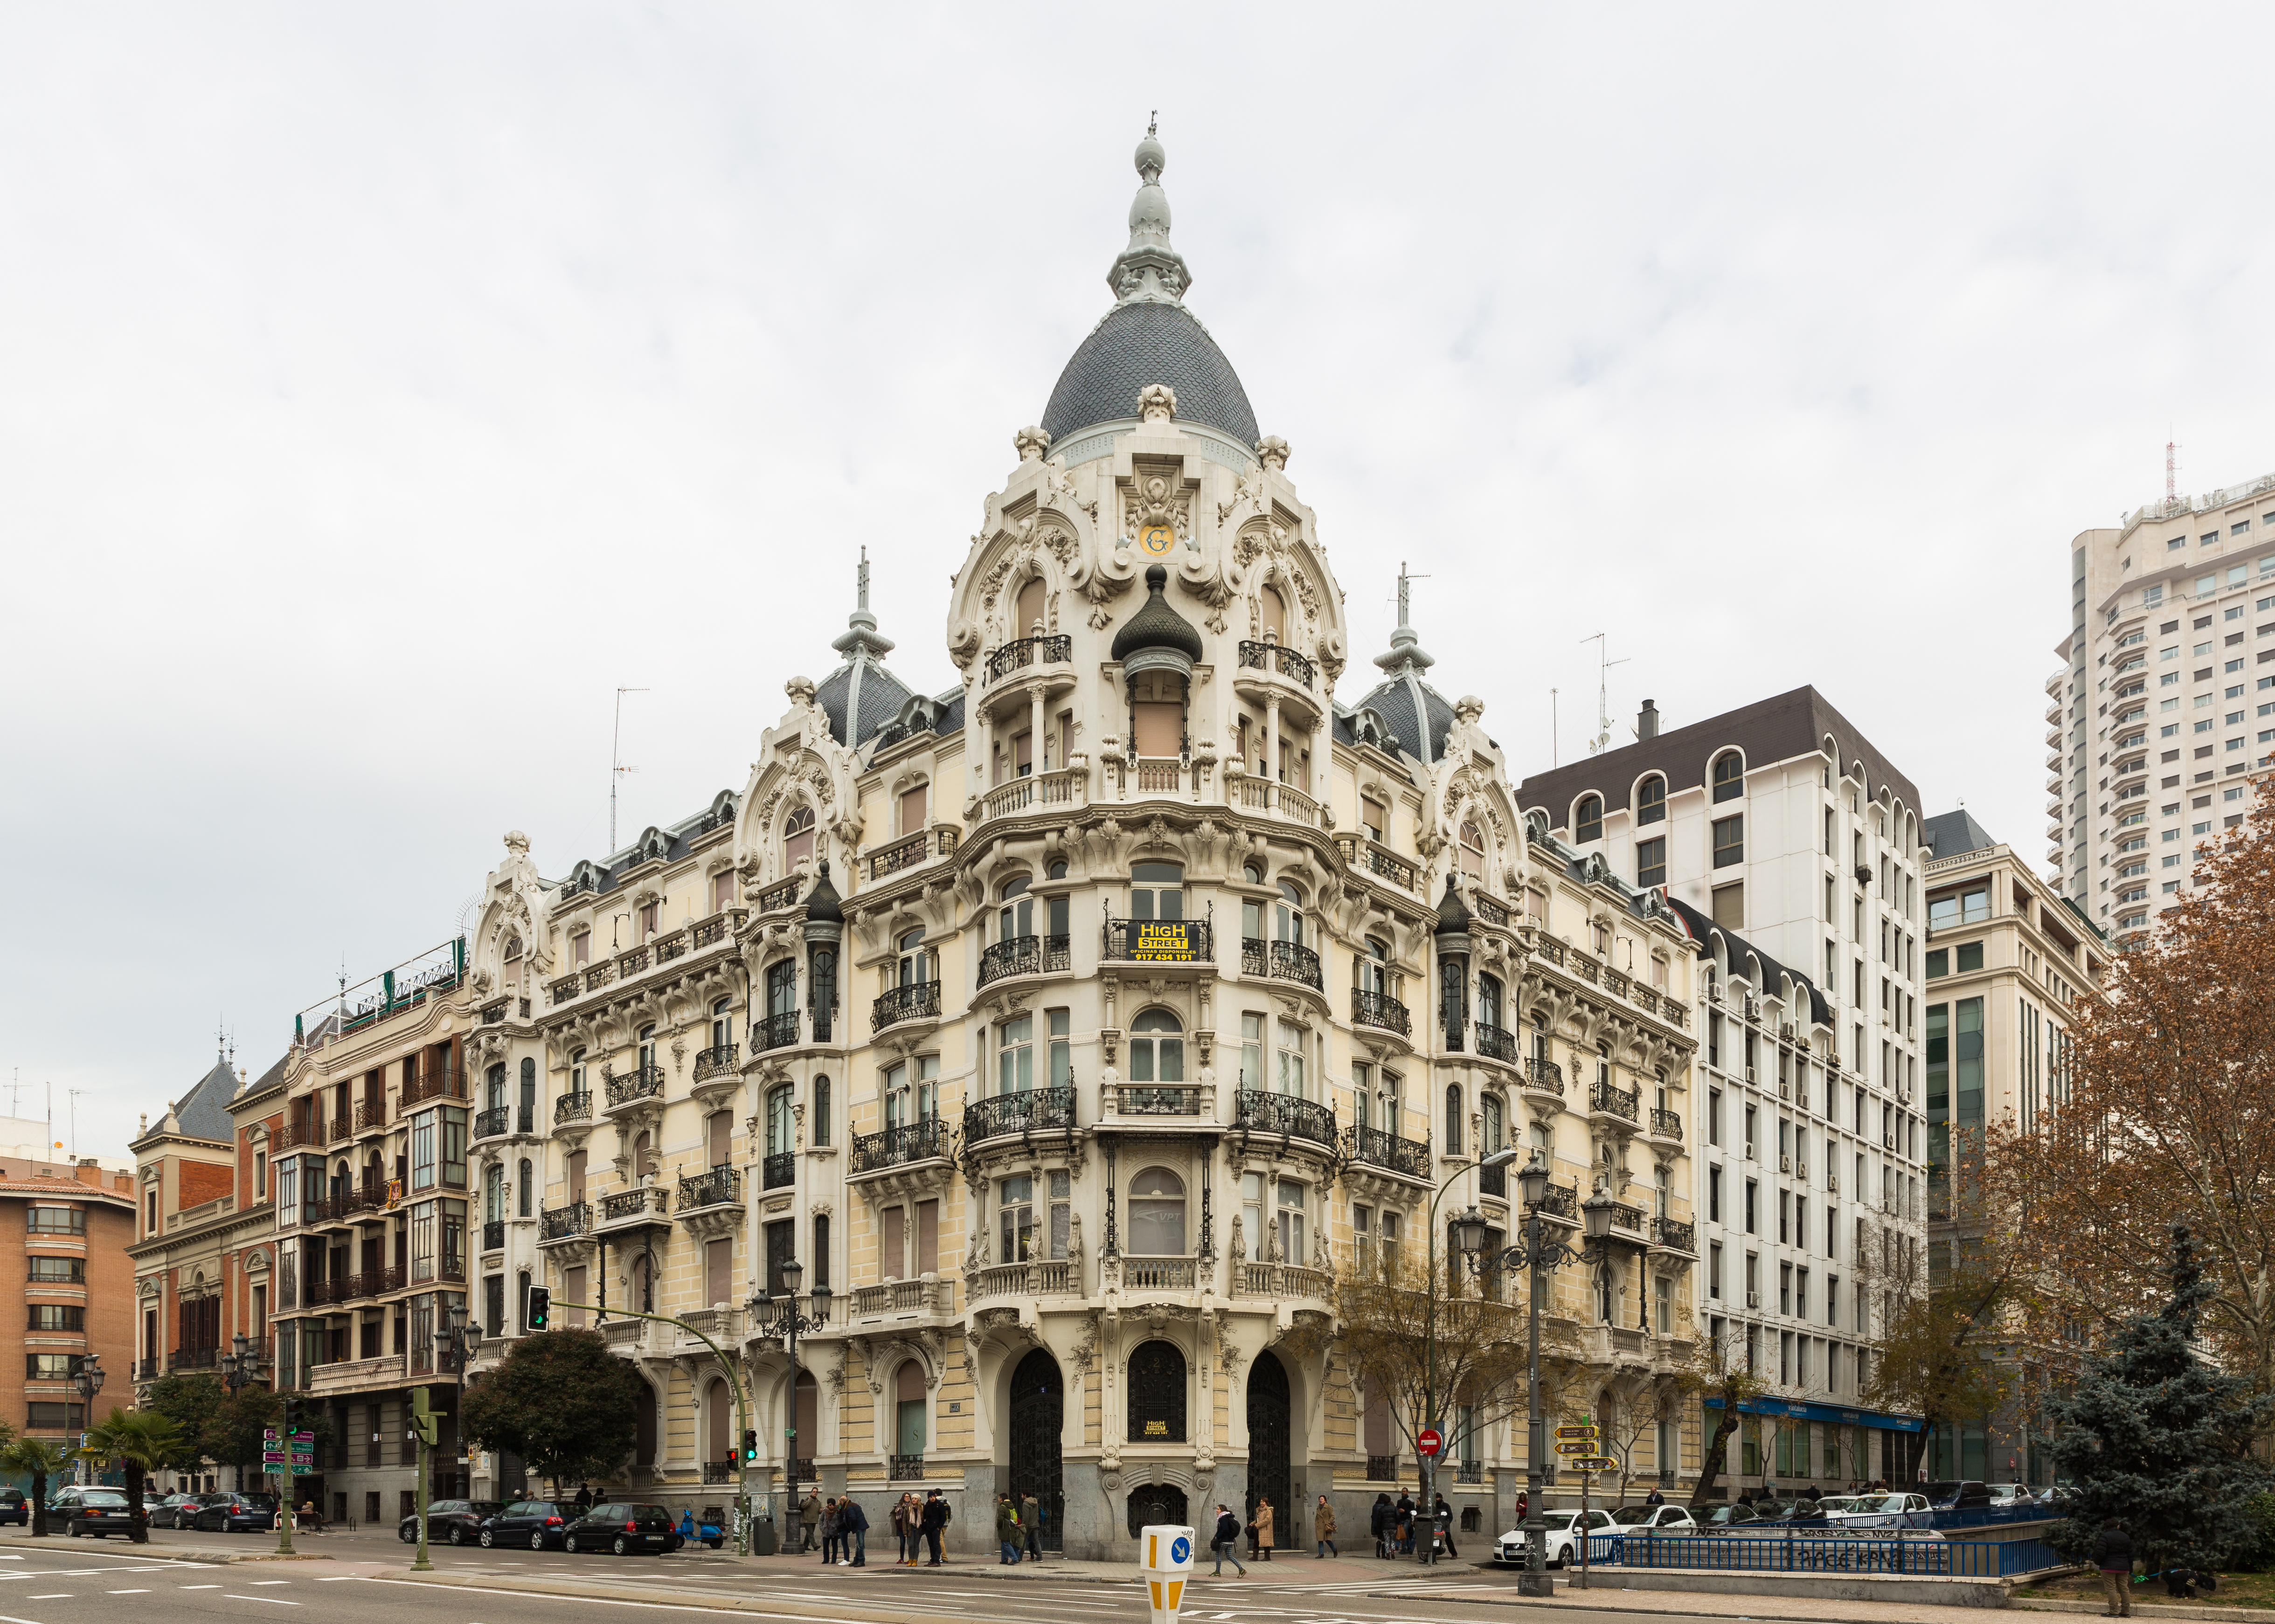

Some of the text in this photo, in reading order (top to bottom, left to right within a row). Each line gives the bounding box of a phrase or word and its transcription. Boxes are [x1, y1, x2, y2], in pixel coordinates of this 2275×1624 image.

[1145, 529, 1168, 552] G
[1141, 924, 1185, 937] HIGH
[1142, 938, 1185, 947] STREET
[1153, 1357, 1160, 1368] 2
[913, 1430, 918, 1441] S
